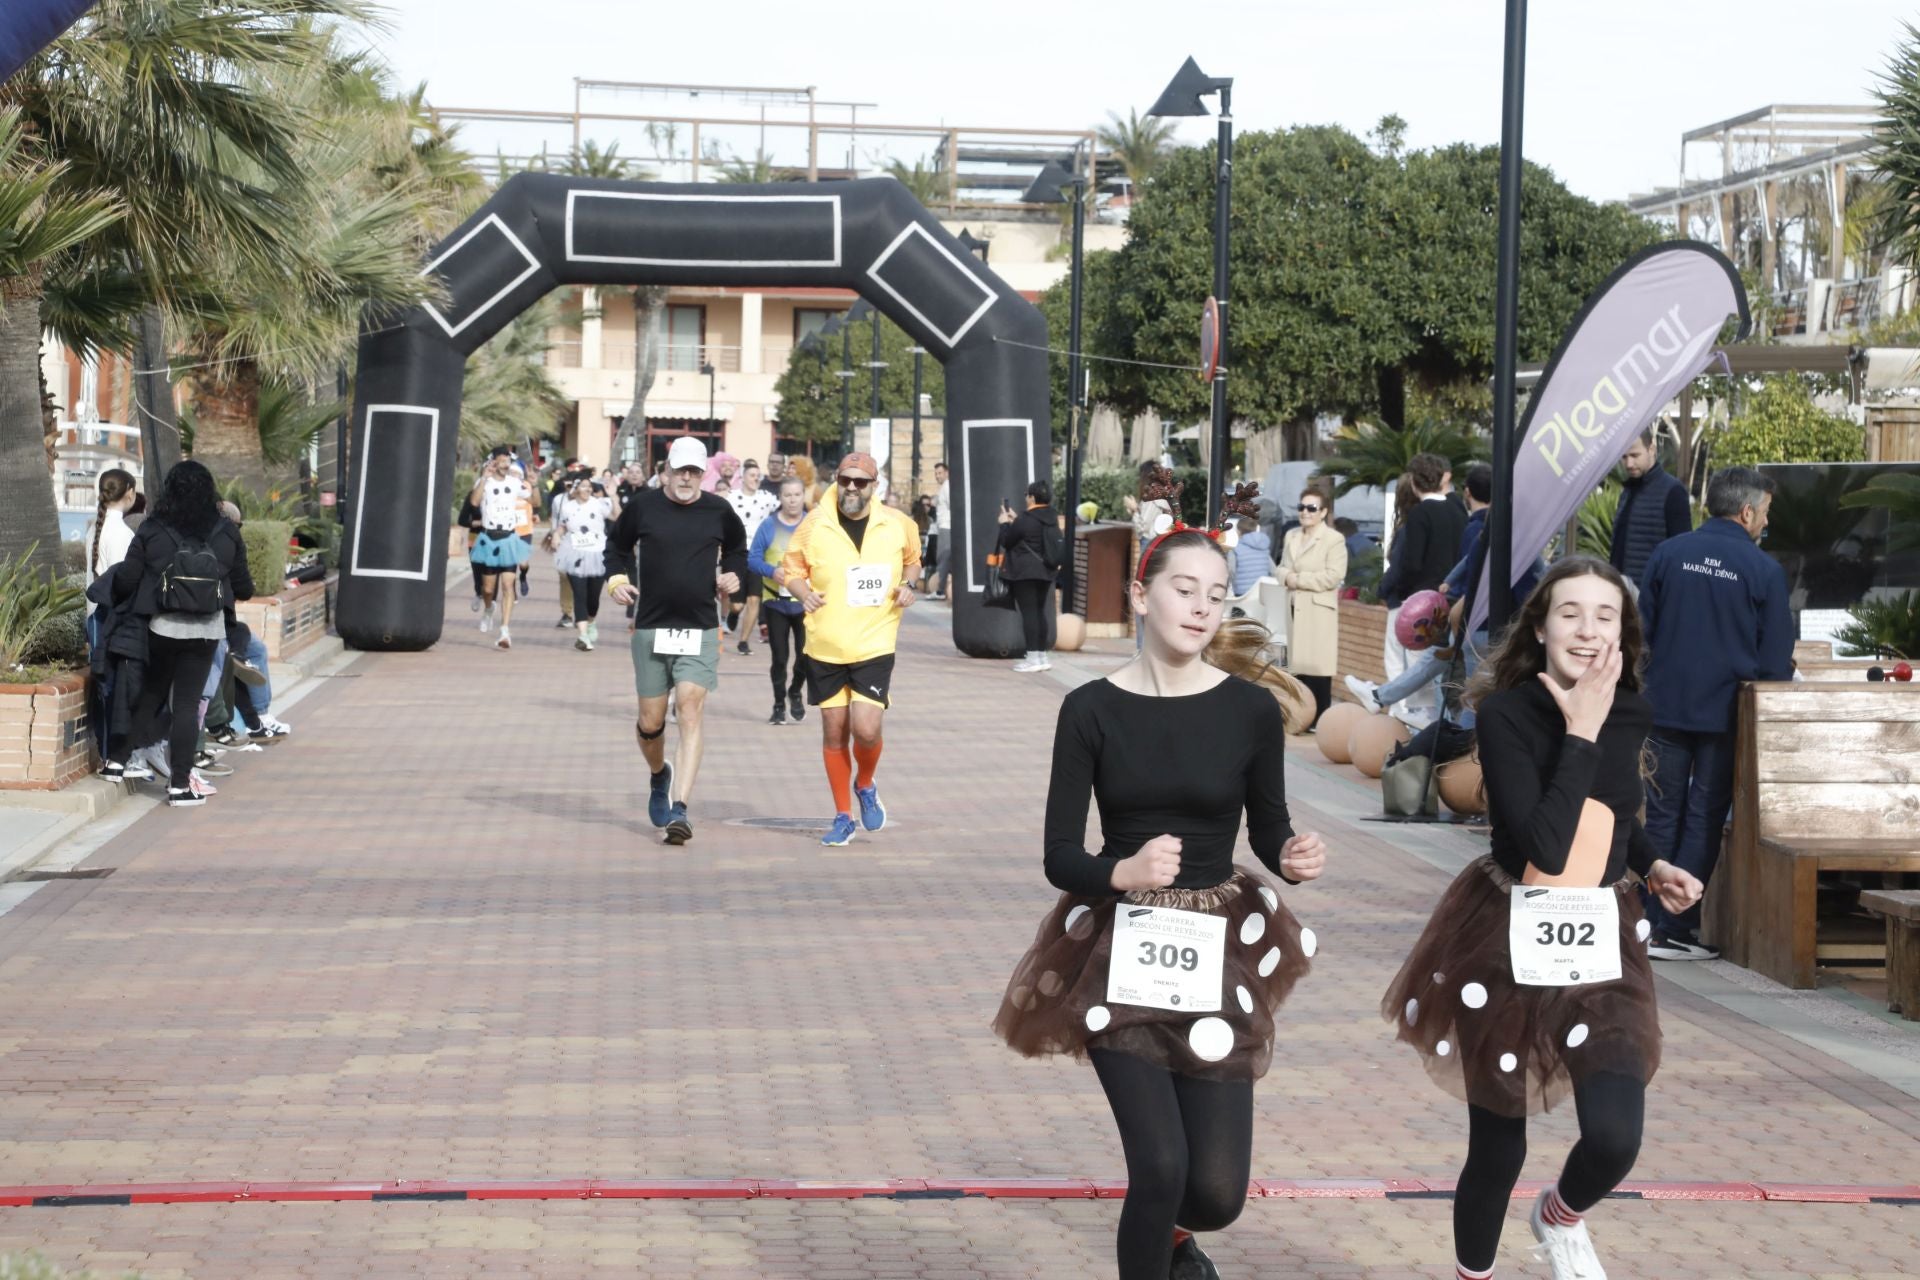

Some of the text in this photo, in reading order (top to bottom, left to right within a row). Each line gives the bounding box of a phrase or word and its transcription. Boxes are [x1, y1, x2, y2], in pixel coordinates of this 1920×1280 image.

[1532, 304, 1691, 478] Pleamar
[1682, 562, 1712, 575] MARINA
[857, 579, 883, 590] 289
[666, 628, 690, 639] 171
[1159, 915, 1195, 927] CARRERA
[1162, 924, 1173, 933] DE
[1536, 921, 1595, 946] 302
[1137, 941, 1199, 972] 309
